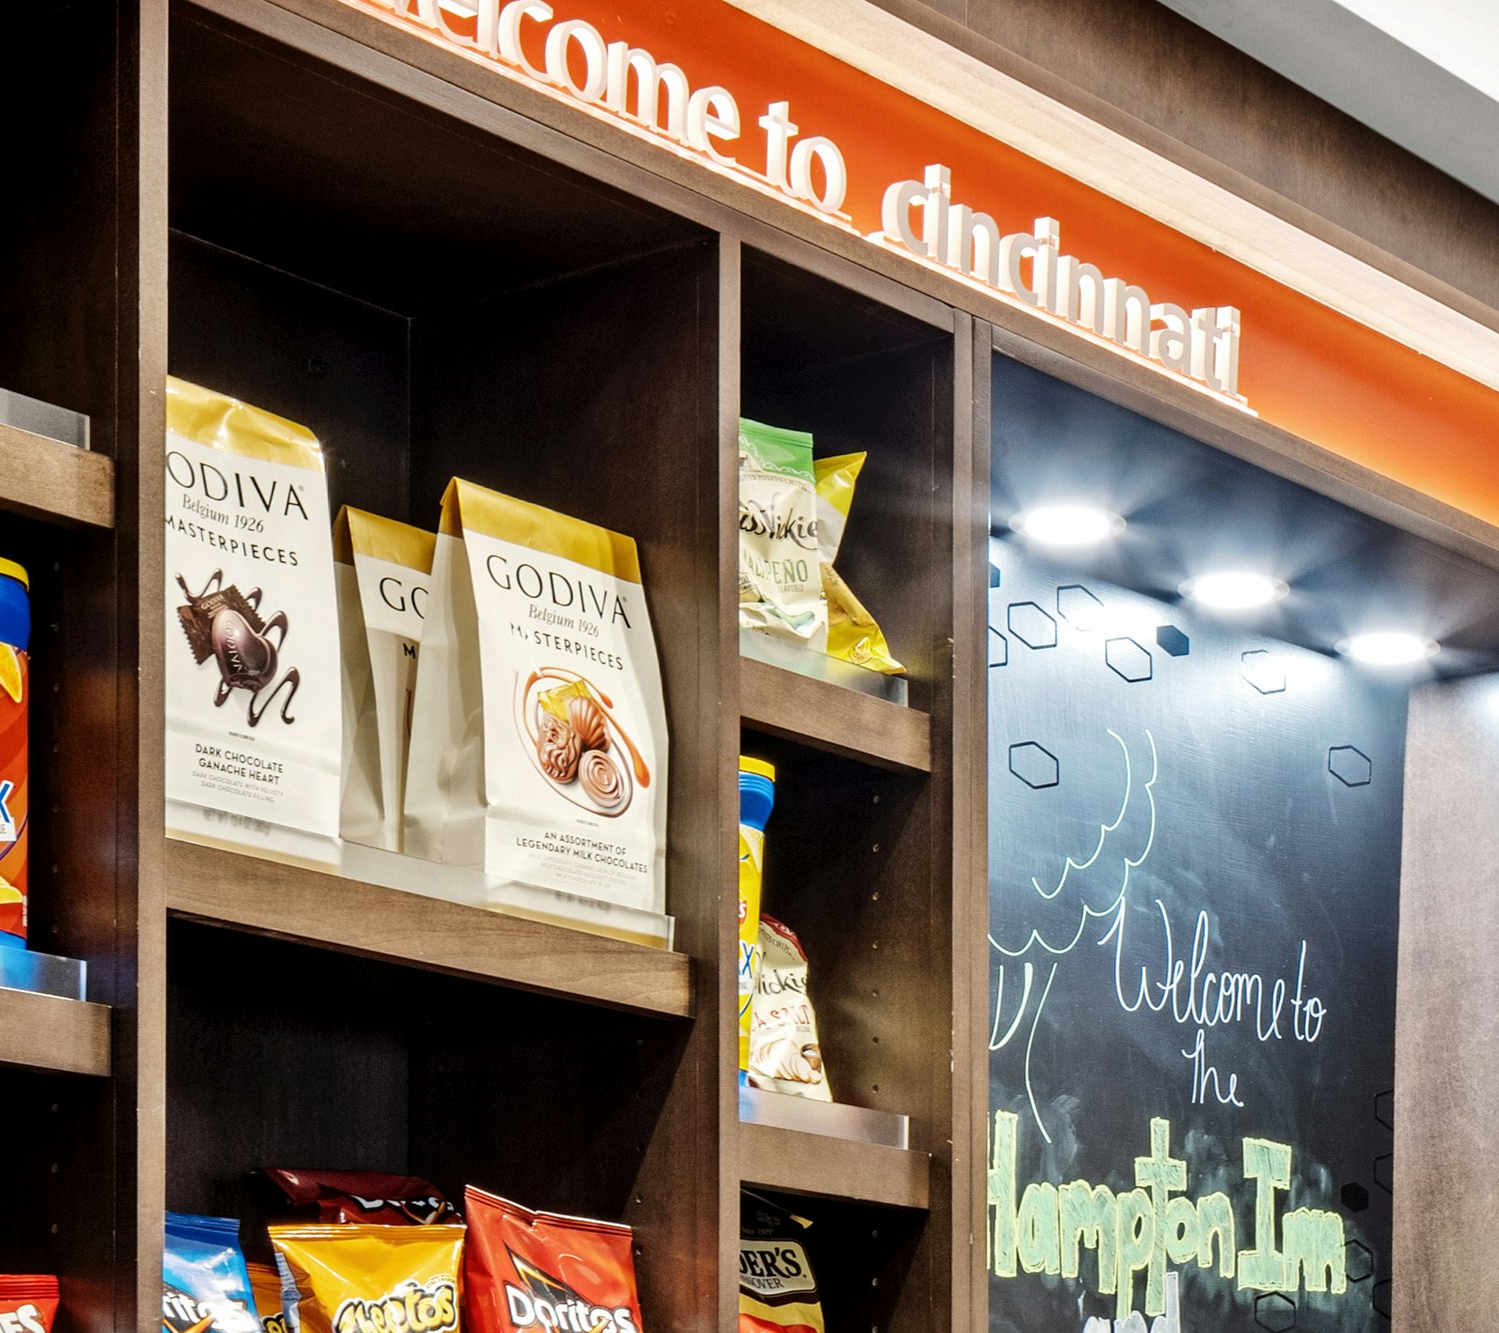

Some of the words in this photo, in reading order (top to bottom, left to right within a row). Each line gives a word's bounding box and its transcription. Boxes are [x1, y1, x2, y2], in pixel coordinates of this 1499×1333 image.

[758, 101, 847, 215] to
[883, 164, 1242, 398] cincinnati
[165, 450, 309, 521] ODIVA
[182, 493, 231, 527] Belgium
[234, 512, 264, 534] 1926
[165, 514, 299, 567] MASTERPIECES
[486, 554, 631, 629] GODIVA
[528, 602, 576, 632] Belgium
[577, 618, 600, 638] 1926
[510, 622, 624, 671] MASTERPIECES
[195, 743, 222, 759] DARK
[224, 750, 284, 774] CHOCOLATE
[198, 758, 246, 778] GANACHE
[248, 771, 281, 786] HEART
[516, 837, 571, 856] LEGENDARY
[573, 849, 593, 861] MILK
[594, 853, 648, 874] CHOCOLATES
[544, 831, 557, 841] AN
[559, 834, 613, 852] ASSORTMENT
[616, 846, 627, 857] OF
[1097, 896, 1285, 1042] Welcome
[1291, 940, 1327, 1042] to
[987, 1109, 1235, 1319] Hampton
[1237, 1136, 1348, 1295] Inn
